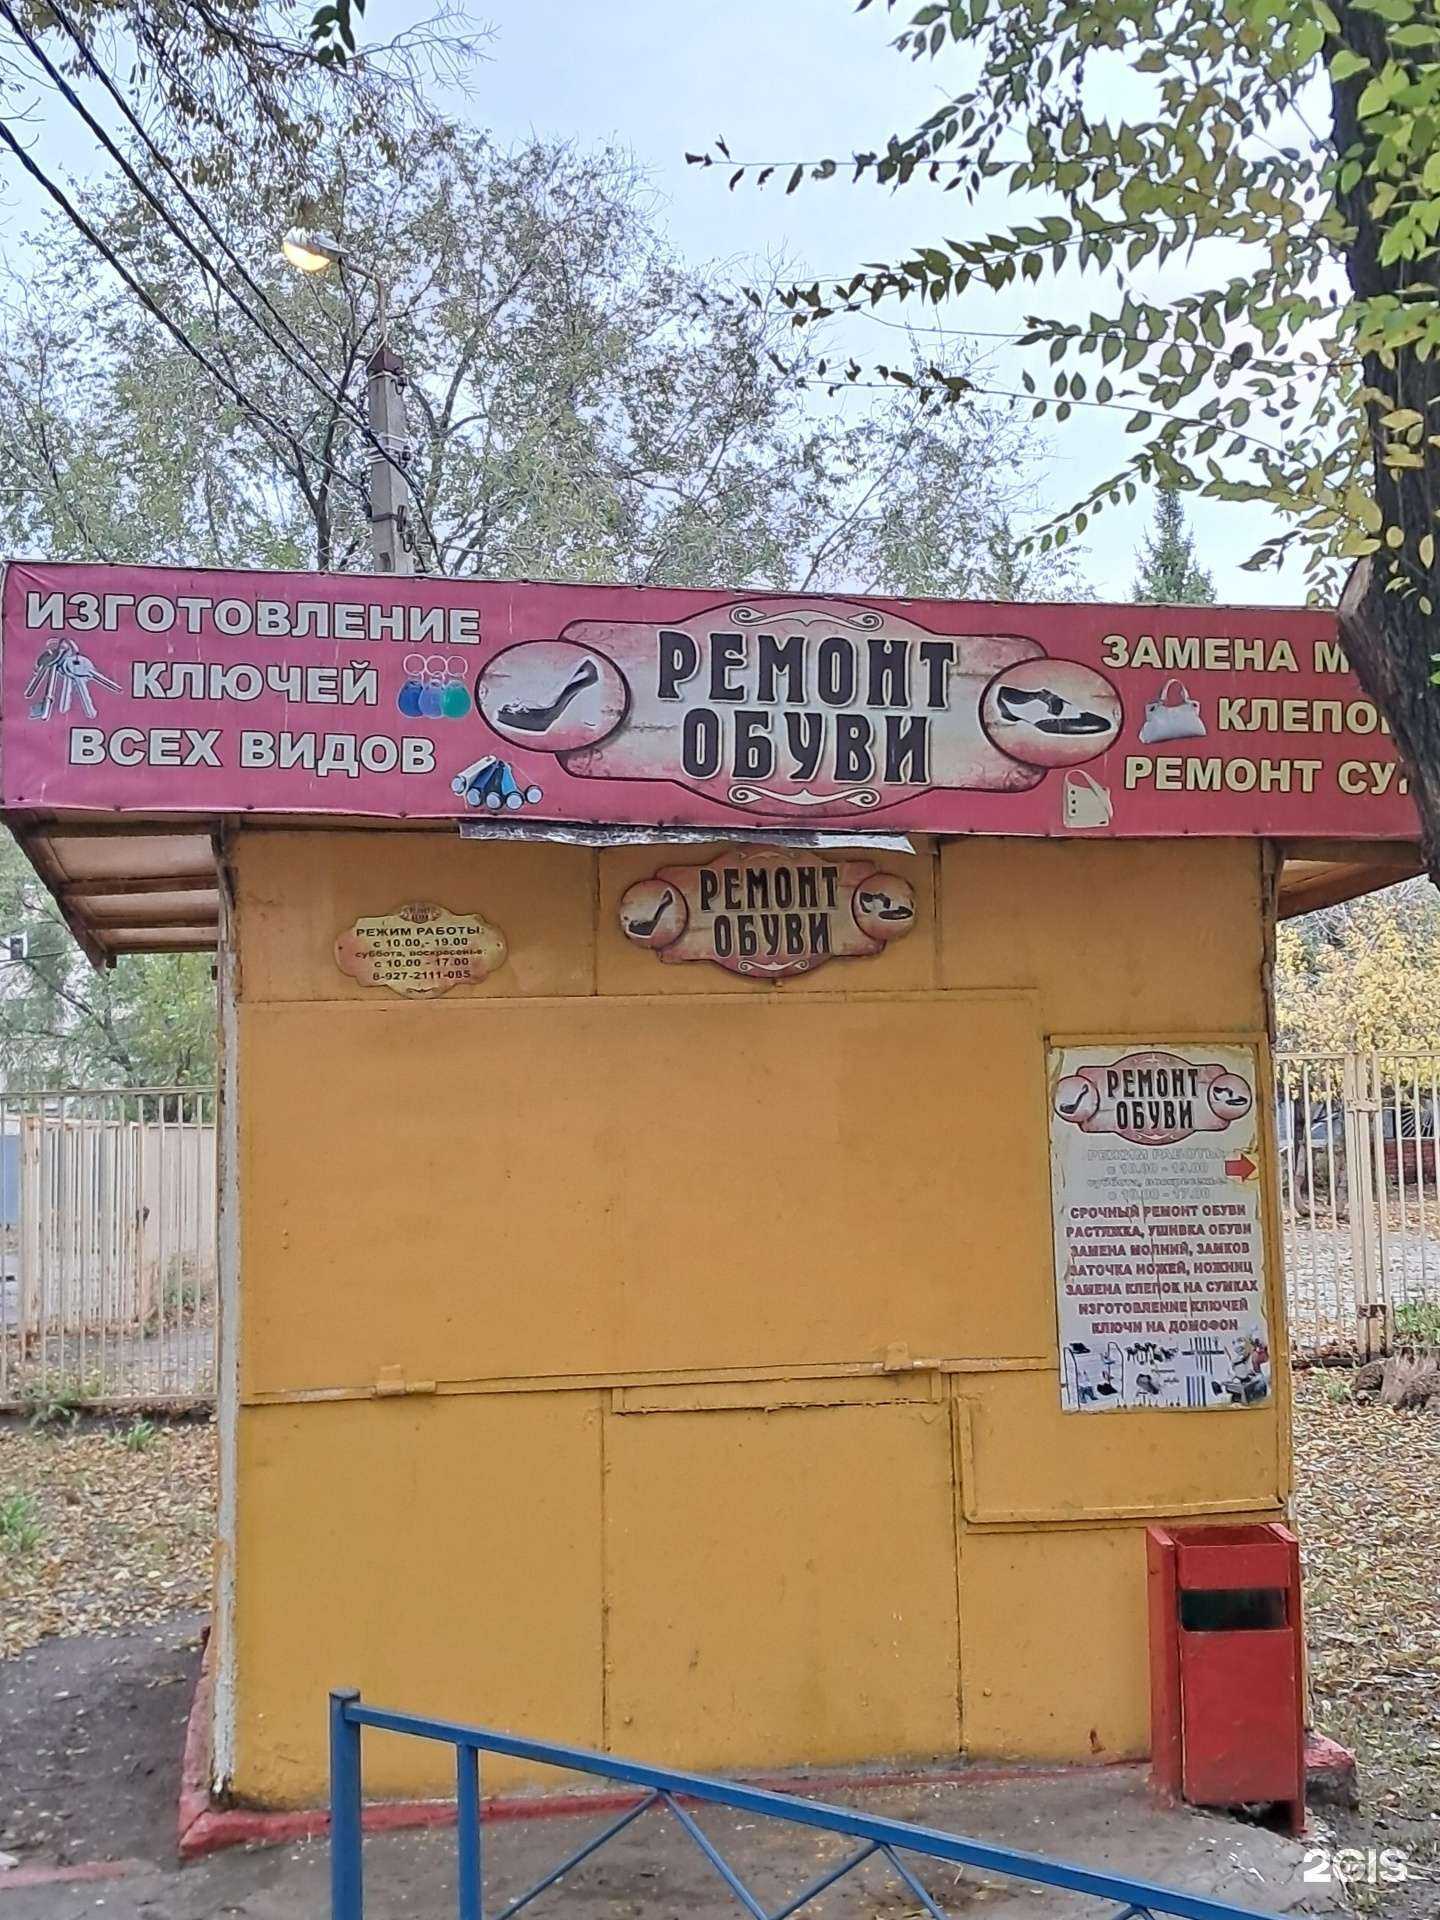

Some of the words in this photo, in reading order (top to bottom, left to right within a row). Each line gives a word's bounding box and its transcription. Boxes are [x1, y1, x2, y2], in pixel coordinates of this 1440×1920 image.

[26, 591, 482, 644] ИЗГОТОВЛЕНИЕ
[1102, 635, 1300, 673] ЗАМЕНА
[657, 630, 958, 708] РЕМОНТ
[132, 660, 378, 705] КЛЮЧЕЙ
[69, 728, 224, 767] ВСЕХ
[240, 731, 436, 777] ВИДОВ
[681, 707, 931, 785] ОБУВИ
[1125, 756, 1323, 793] РЕМОНТ
[1337, 760, 1408, 795] СУ
[699, 866, 839, 911] РЕМОНТ
[356, 928, 411, 937] РЕЖИМ
[416, 926, 485, 936] РАБОТЫ:
[713, 912, 831, 958] ОБУВИ
[435, 937, 468, 946] 19.00
[355, 950, 406, 959] суббота,
[386, 959, 421, 968] 10.00
[436, 957, 469, 967] 17.00
[372, 969, 471, 981] 8-927-2111-085
[1106, 1068, 1199, 1098] РЕМОНТ
[1116, 1100, 1194, 1129] ОБУВИ
[1070, 1204, 1139, 1219] СРОЧНЫЙ
[1143, 1205, 1198, 1218] РЕМОНТ
[1202, 1204, 1246, 1217] ОБУВИ
[1066, 1225, 1144, 1238] РАСТЯЖКА,
[1148, 1224, 1205, 1237] УШИВКА
[1208, 1223, 1252, 1236] ОБУВИ
[1070, 1245, 1126, 1257] ЗАМЕНА
[1130, 1241, 1193, 1257] МОЛНИЙ,
[1197, 1242, 1250, 1255] ЗАМКОВ
[1070, 1264, 1132, 1276] ЗАТОЧКА
[1136, 1261, 1190, 1276] НОЖЕЙ,
[1194, 1261, 1253, 1274] НОЖНИЦ
[1066, 1283, 1122, 1296] ЗАМЕНА
[1125, 1282, 1181, 1295] КЛЕПОК
[1183, 1281, 1203, 1294] НА
[1206, 1279, 1258, 1293] СУМКАХ
[1079, 1301, 1187, 1315] ИЗГОТОВЛЕНИЕ
[1191, 1297, 1248, 1313] КЛЮЧЕЙ
[1092, 1321, 1143, 1335] КЛЮЧИ
[1146, 1320, 1166, 1333] НА
[1169, 1319, 1238, 1334] ДОМОФОН
